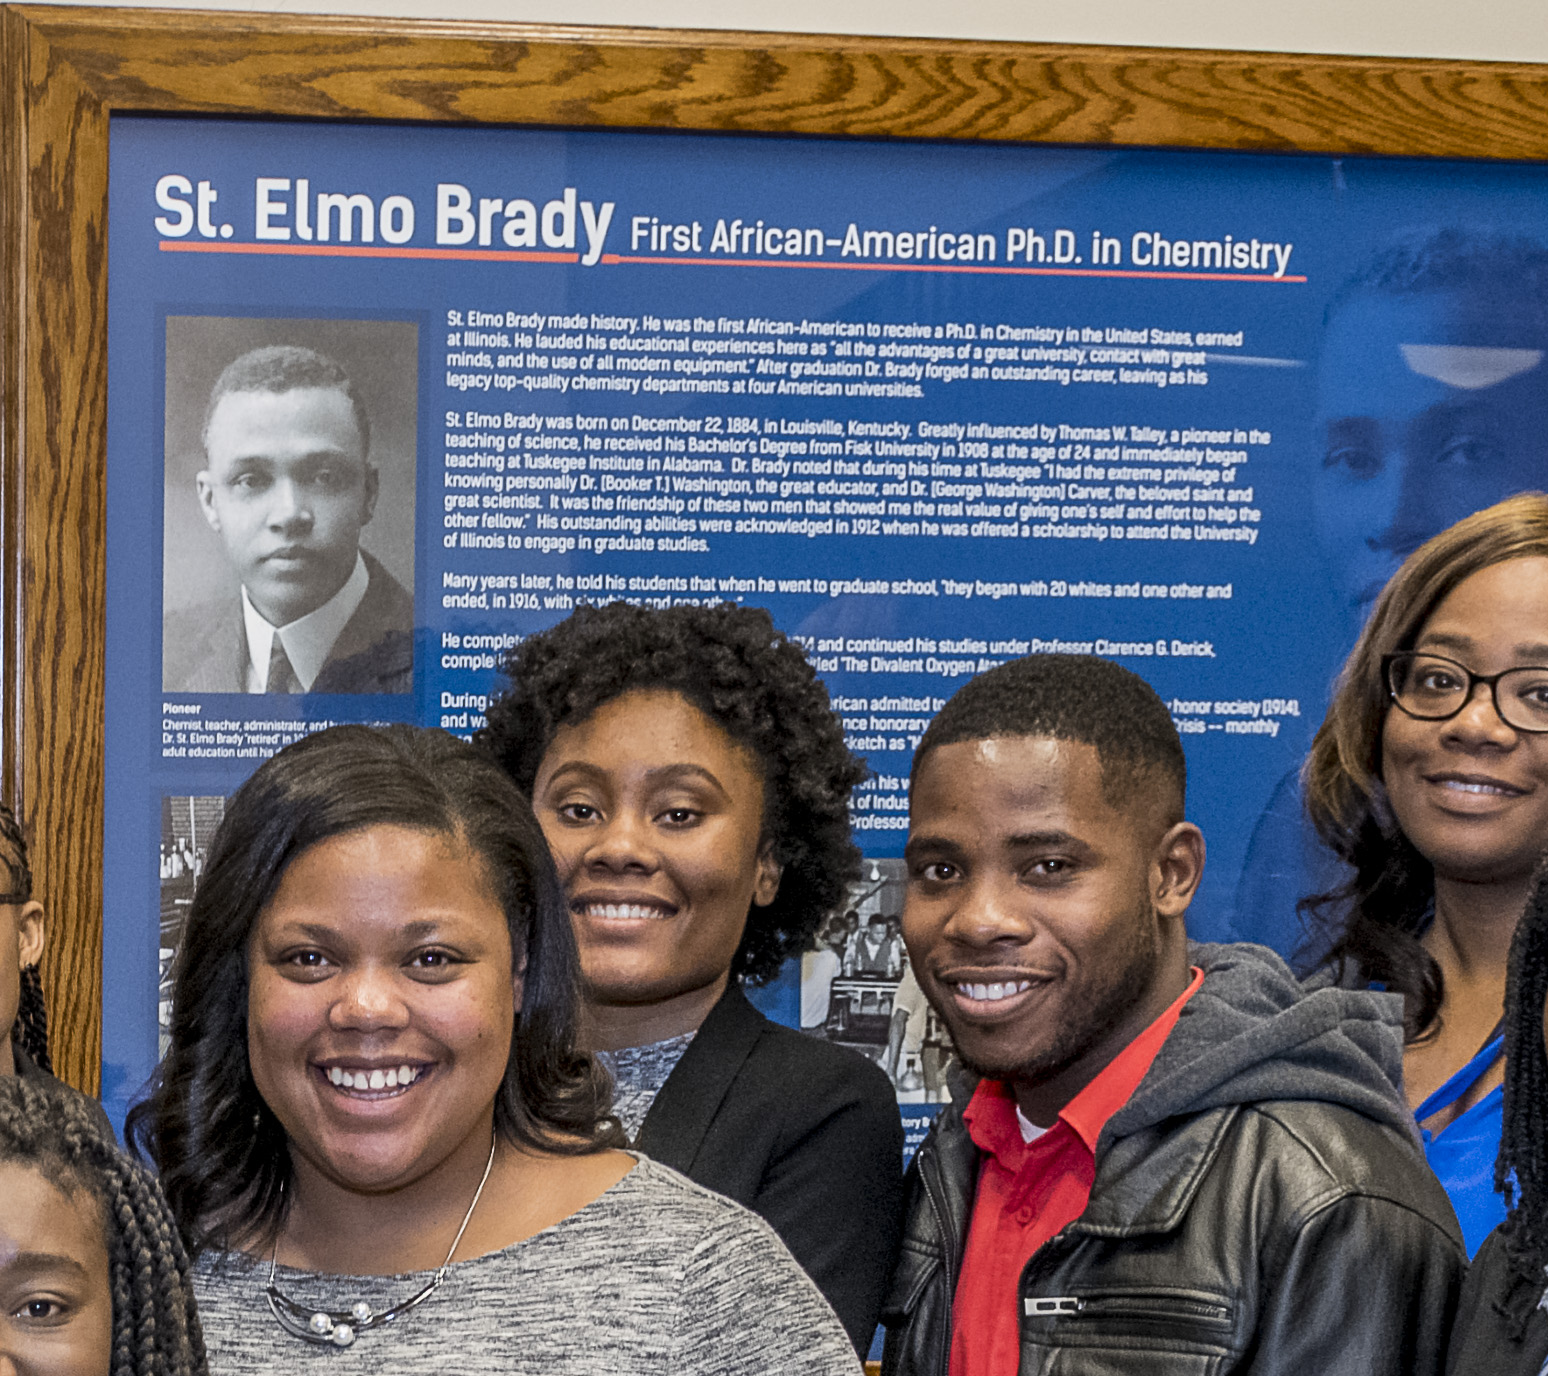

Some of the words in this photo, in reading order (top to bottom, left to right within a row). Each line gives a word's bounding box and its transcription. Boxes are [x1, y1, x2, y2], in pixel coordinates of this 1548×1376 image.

[153, 176, 232, 241] St.
[255, 178, 414, 246] Elmo
[436, 182, 616, 267] Brady
[631, 217, 701, 253] First
[710, 219, 995, 262] African-American
[1006, 227, 1080, 264] Ph.D.
[1092, 230, 1120, 266] in
[1131, 231, 1292, 279] Chemistry
[446, 311, 464, 328] St.
[467, 311, 503, 329] Elmo
[505, 312, 546, 334] Brady
[547, 313, 588, 331] made
[590, 314, 639, 336] history.
[642, 315, 660, 333] He
[663, 319, 691, 333] was
[693, 317, 715, 334] the
[717, 317, 744, 335] first
[746, 318, 864, 338] African-American
[866, 321, 880, 338] to
[882, 321, 931, 339] receive
[934, 326, 943, 340] a
[945, 323, 976, 340] Ph.D.
[980, 324, 993, 341] in
[995, 324, 1064, 347] Chemistry
[1065, 326, 1079, 343] in
[1081, 326, 1103, 344] the
[1105, 327, 1148, 345] United
[1150, 328, 1192, 348] States,
[1195, 329, 1244, 347] earned
[162, 719, 202, 733] Chemist,
[204, 719, 241, 733] teacher,
[243, 720, 306, 734] administrator,
[309, 720, 329, 732] and
[163, 703, 201, 715] Pioneer
